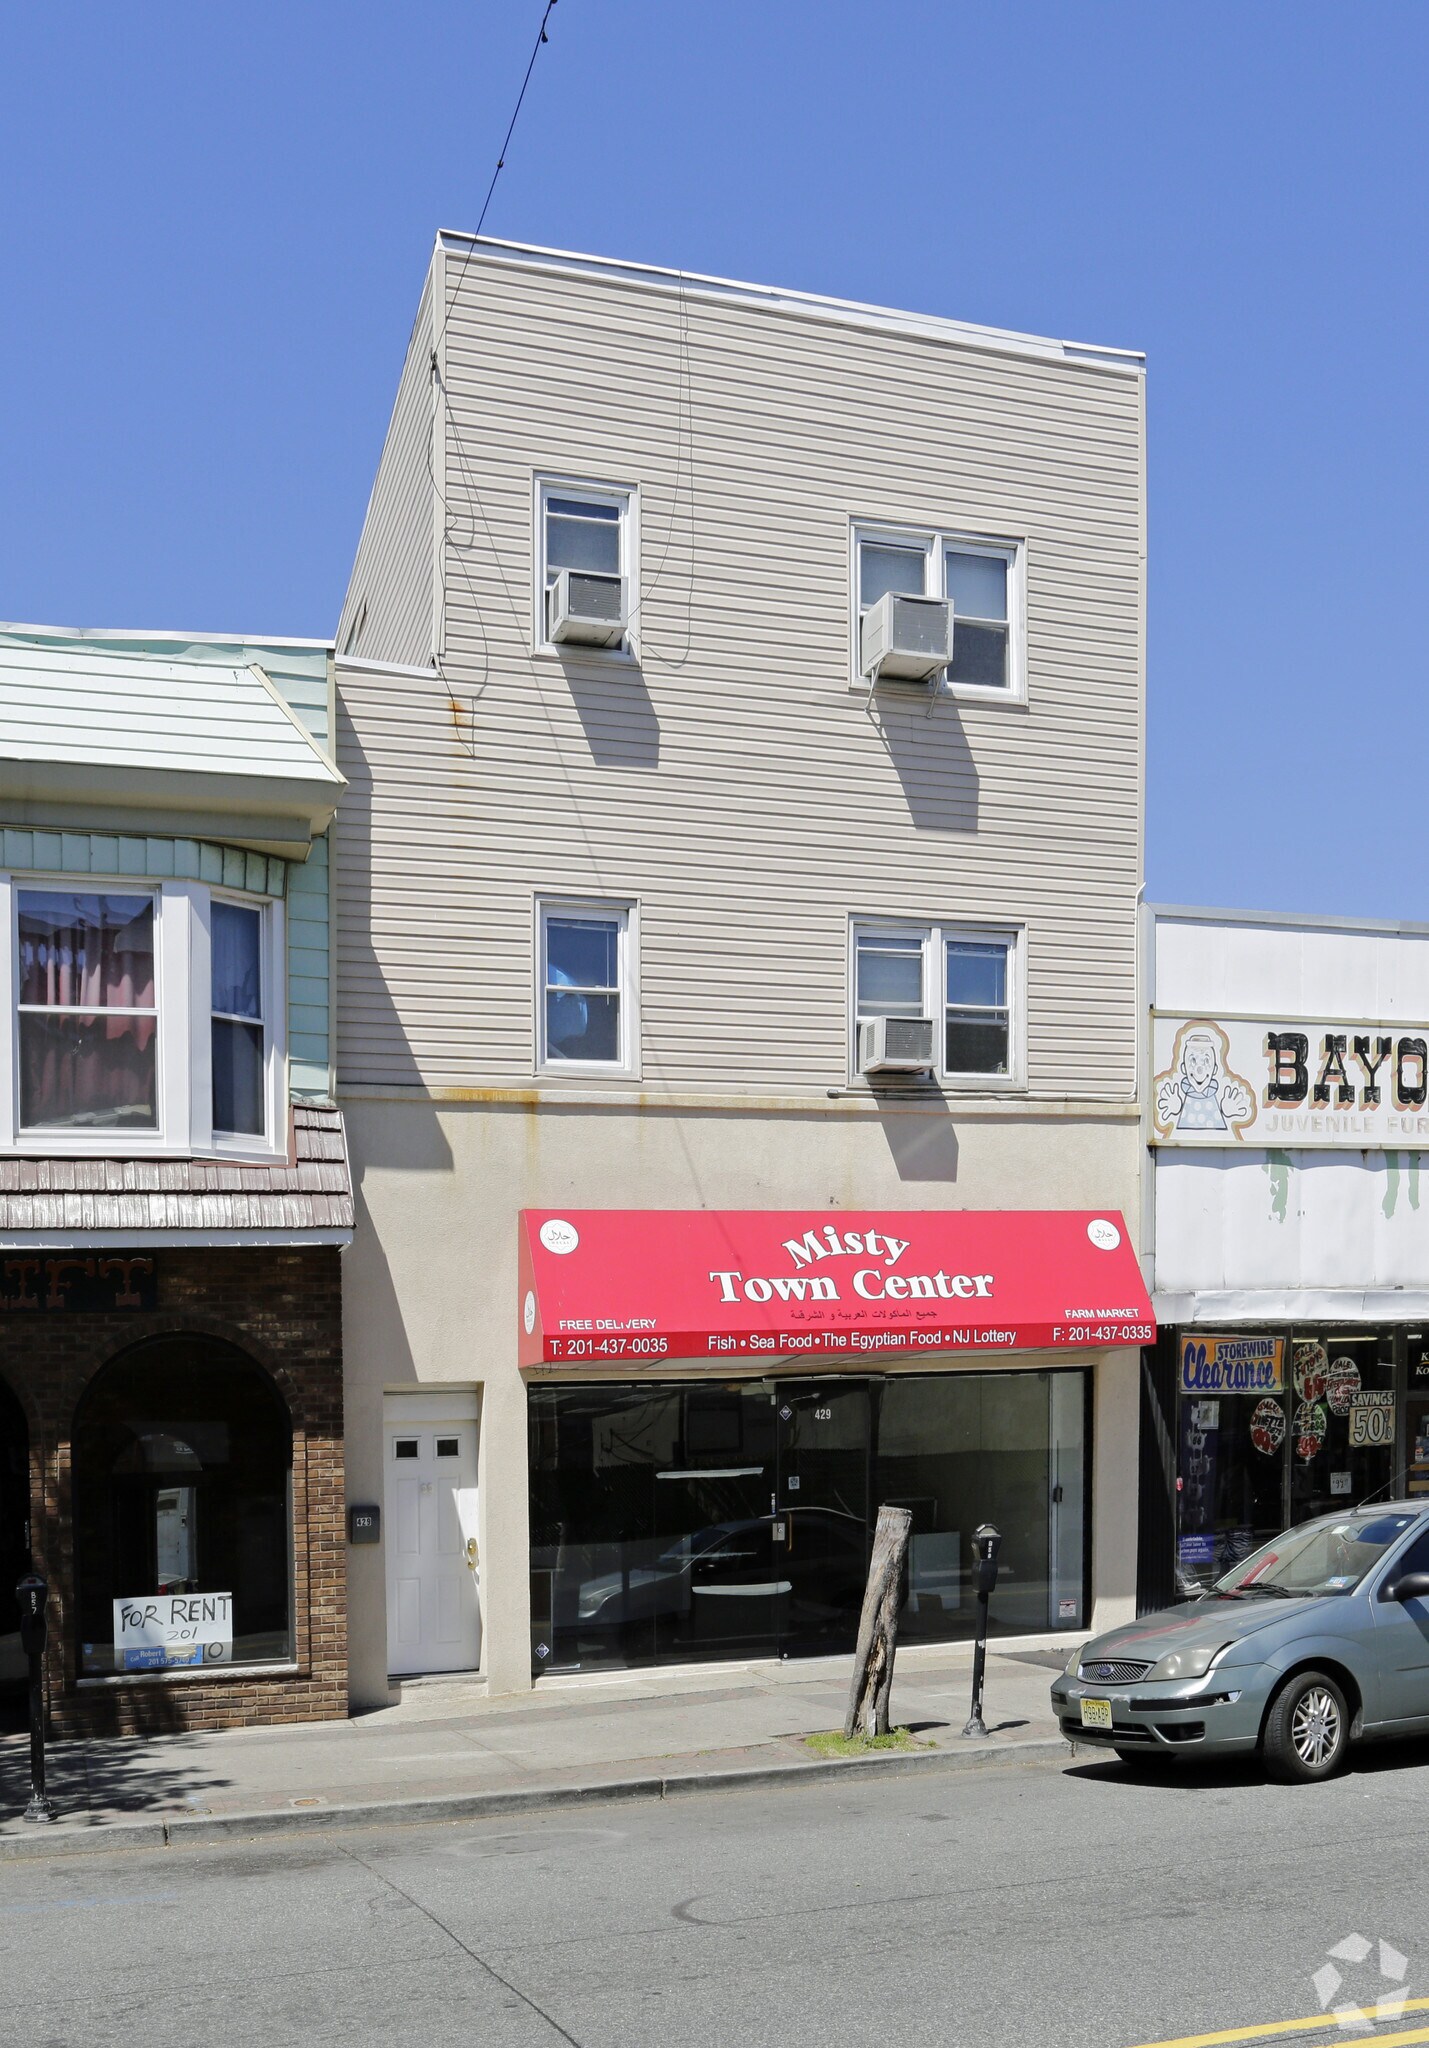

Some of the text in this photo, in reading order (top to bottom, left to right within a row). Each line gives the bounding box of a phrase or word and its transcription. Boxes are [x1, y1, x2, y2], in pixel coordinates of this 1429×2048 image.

[1265, 1114, 1376, 1133] JUVENILE
[782, 1225, 910, 1270] Misty
[709, 1269, 994, 1303] Town Center
[1065, 1308, 1139, 1319] FARM MARKET
[559, 1320, 594, 1331] FREE
[1053, 1325, 1152, 1342] F: 201-437-0335
[550, 1337, 668, 1355] T: 201-437-0035
[708, 1328, 1017, 1350] Fish Sea Food The Egyptian Food NJ Lottery
[1217, 1340, 1273, 1361] STOREWIDE
[1183, 1341, 1276, 1389] Clearance
[1351, 1393, 1393, 1406] SAVINGS
[815, 1408, 832, 1420] 429
[1353, 1408, 1392, 1443] 50%
[121, 1595, 232, 1632] FOR RENT
[167, 1626, 197, 1641] 201
[140, 1650, 161, 1658] Robert
